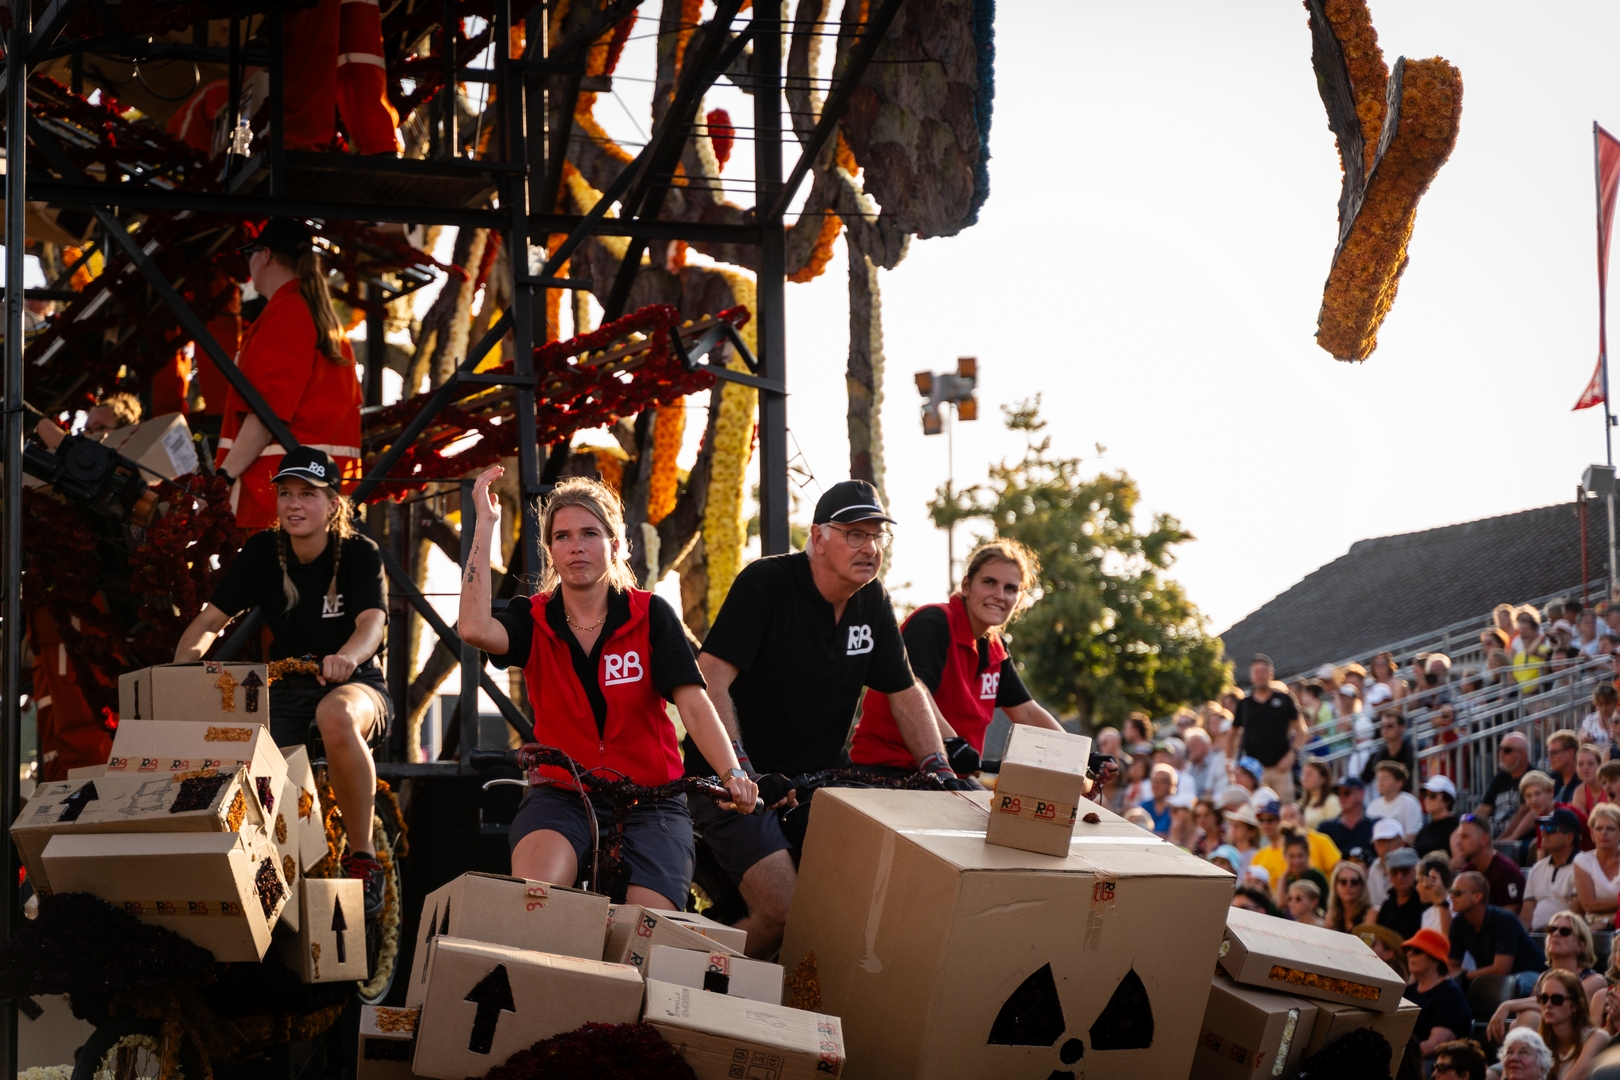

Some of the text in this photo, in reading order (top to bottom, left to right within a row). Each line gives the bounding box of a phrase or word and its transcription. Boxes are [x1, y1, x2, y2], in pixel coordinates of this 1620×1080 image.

[308, 461, 325, 477] RB
[846, 624, 874, 656] RB
[603, 650, 644, 687] RB
[108, 757, 128, 771] RB
[138, 757, 159, 771] RB
[169, 759, 189, 771] RB
[1000, 795, 1021, 815] RB
[1034, 801, 1056, 820] RB
[1101, 881, 1115, 902] RB
[156, 901, 176, 915] RB
[188, 900, 209, 915] RB
[220, 901, 240, 916] RB
[637, 912, 657, 939] RB
[817, 1052, 839, 1076] RB
